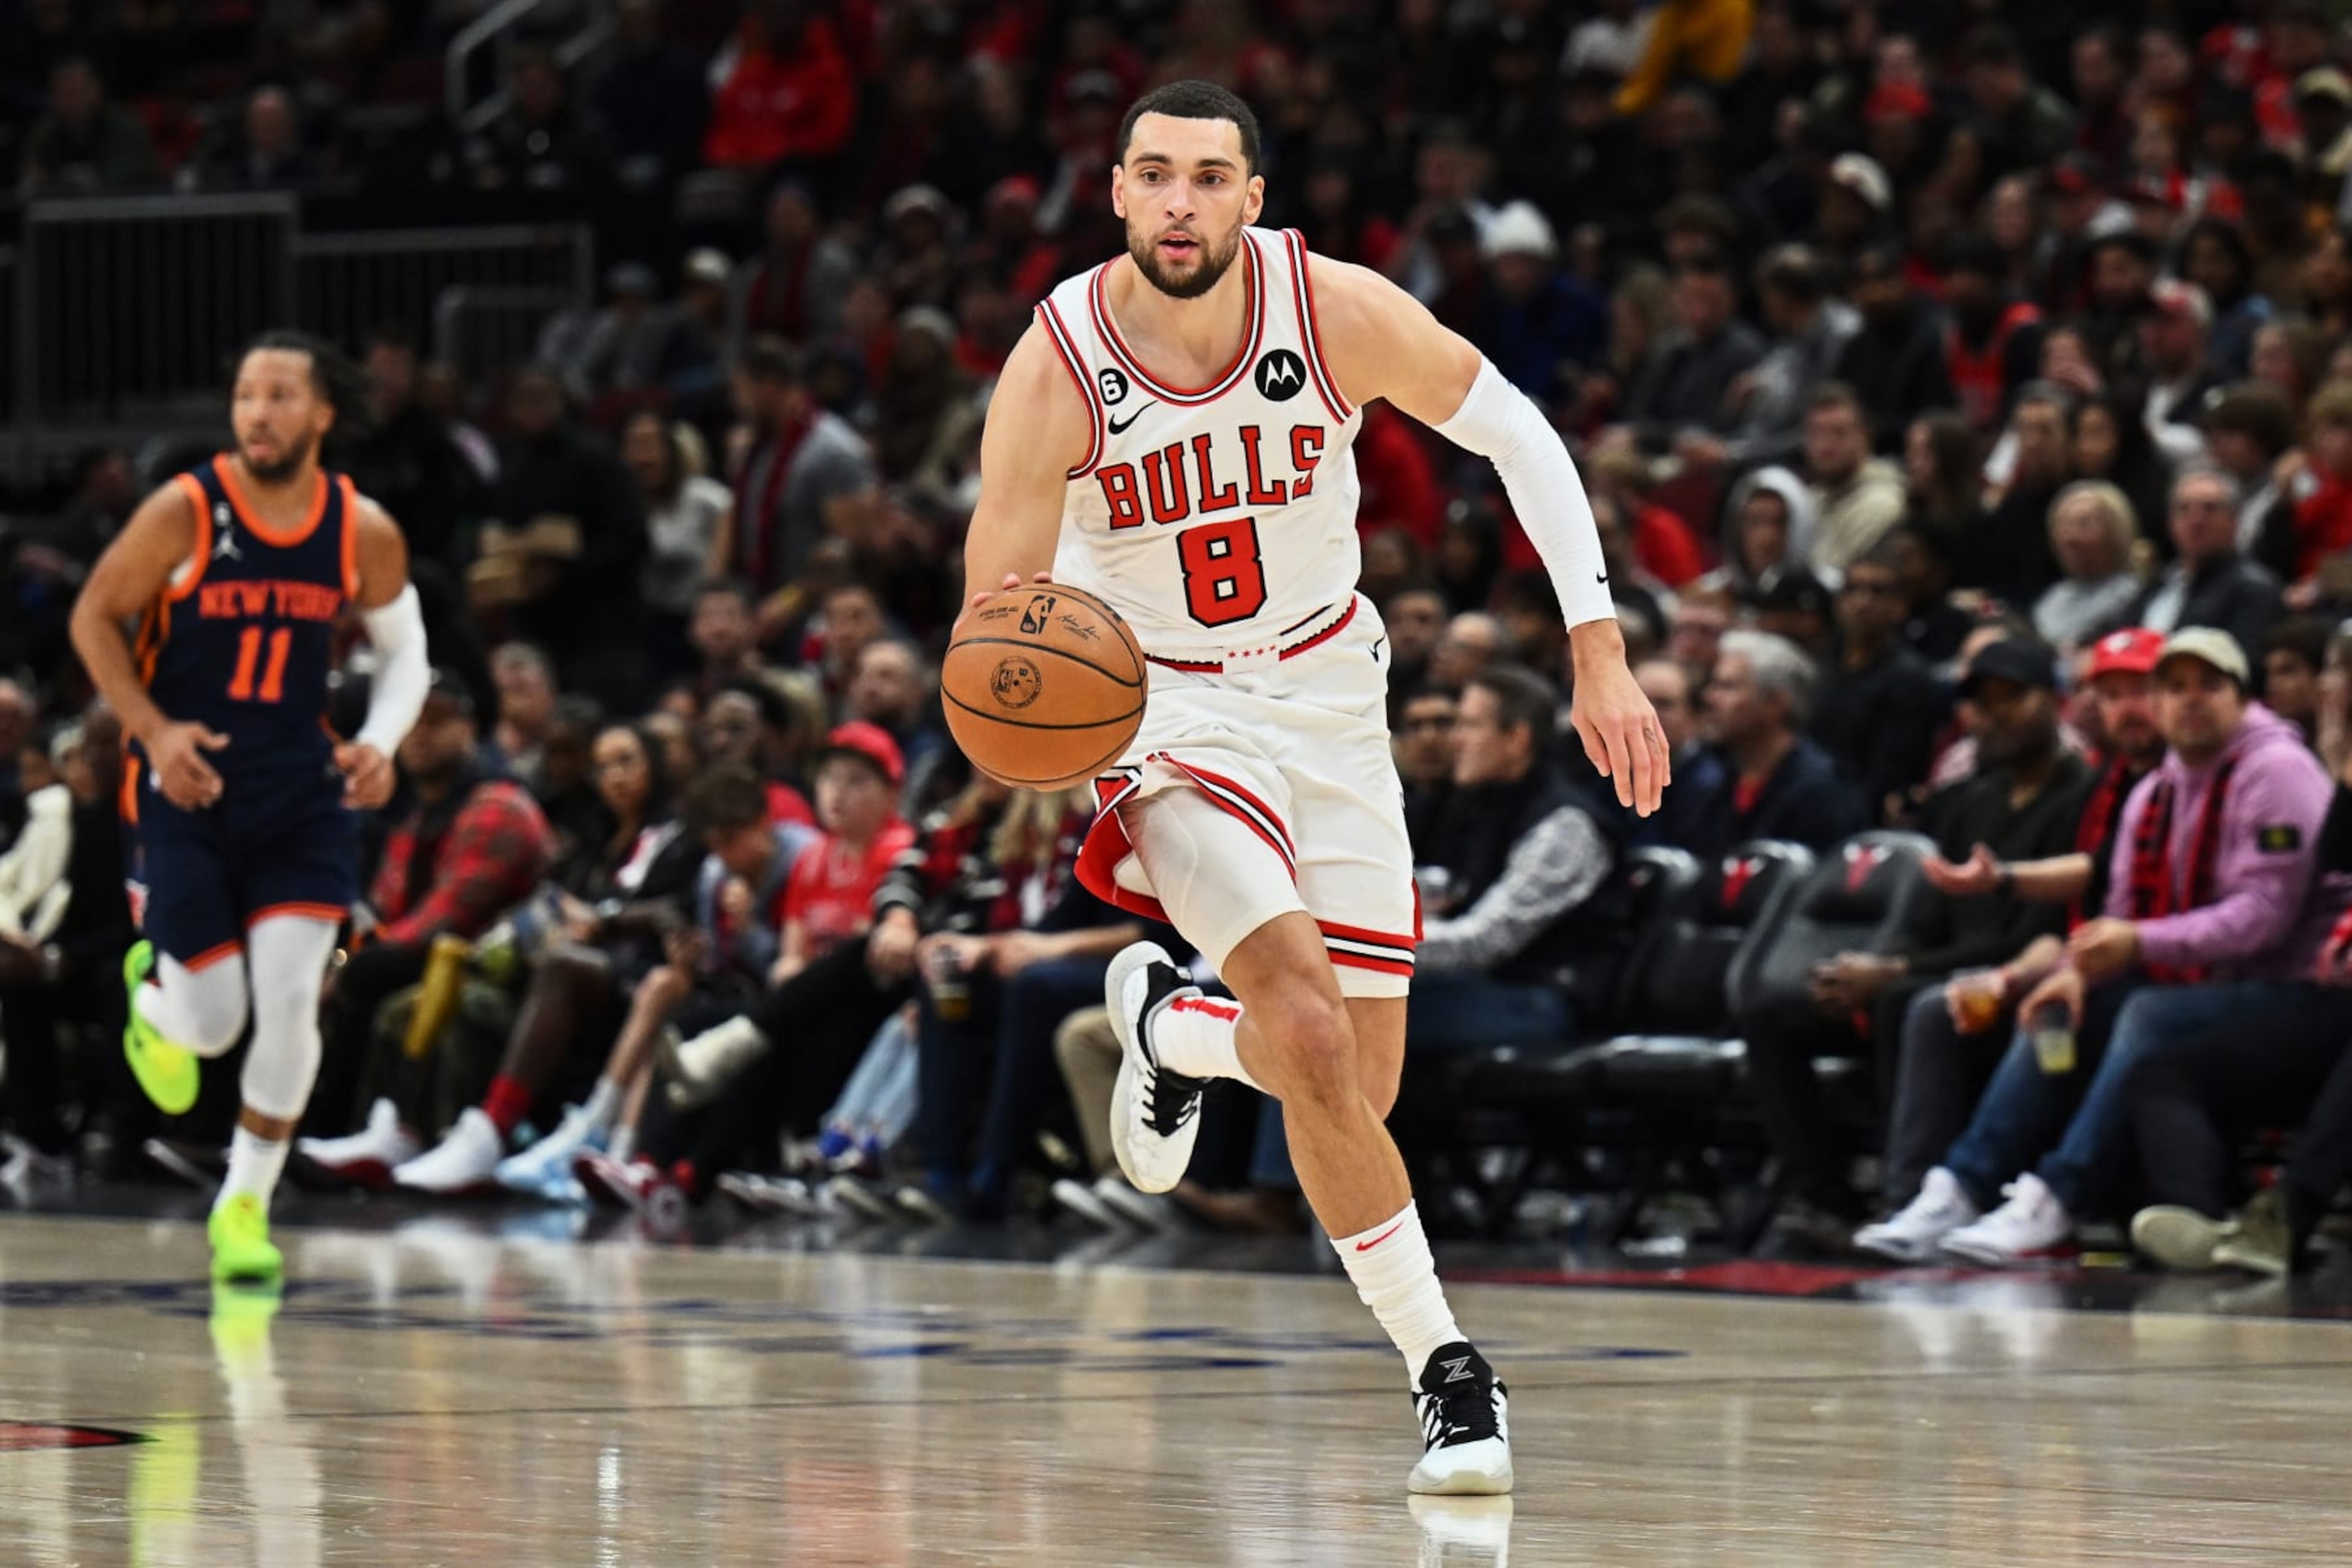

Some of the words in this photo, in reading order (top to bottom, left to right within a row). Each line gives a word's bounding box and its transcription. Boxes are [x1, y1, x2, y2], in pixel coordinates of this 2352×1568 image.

[1101, 374, 1121, 401] 6
[1095, 424, 1324, 530] BULLS
[200, 579, 271, 618] NEW
[1177, 517, 1267, 628] 8
[227, 625, 292, 701] 11
[1438, 1356, 1475, 1384] Z
